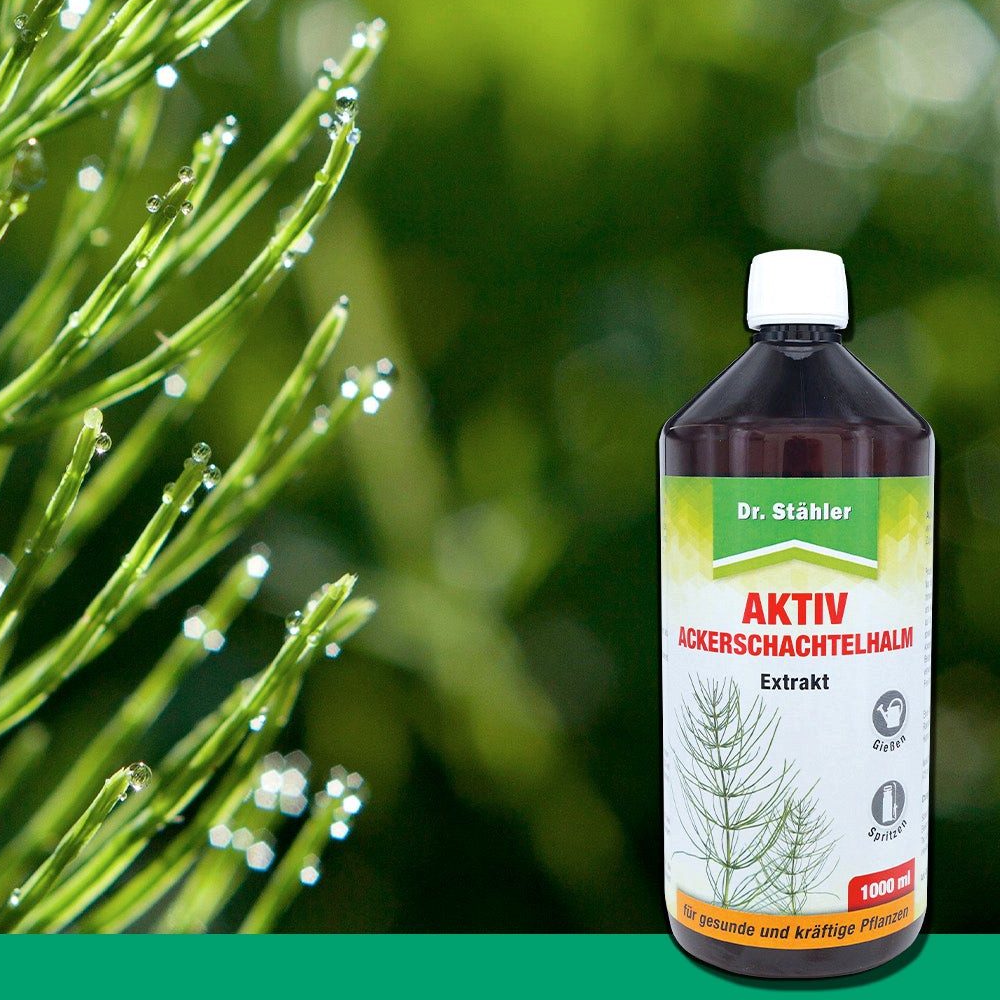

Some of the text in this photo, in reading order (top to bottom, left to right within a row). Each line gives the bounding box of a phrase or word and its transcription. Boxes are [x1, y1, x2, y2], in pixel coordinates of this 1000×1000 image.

[737, 501, 852, 521] Dr. Stähler
[742, 592, 848, 625] AKTIV
[678, 626, 913, 658] ACKERSCHACHTELHALM
[760, 673, 830, 690] Extrakt
[872, 735, 906, 753] Gießen
[868, 819, 907, 842] Spritzen
[860, 870, 911, 900] 1000 ml
[683, 904, 909, 940] für gesunde und kräftige Pflanzen
